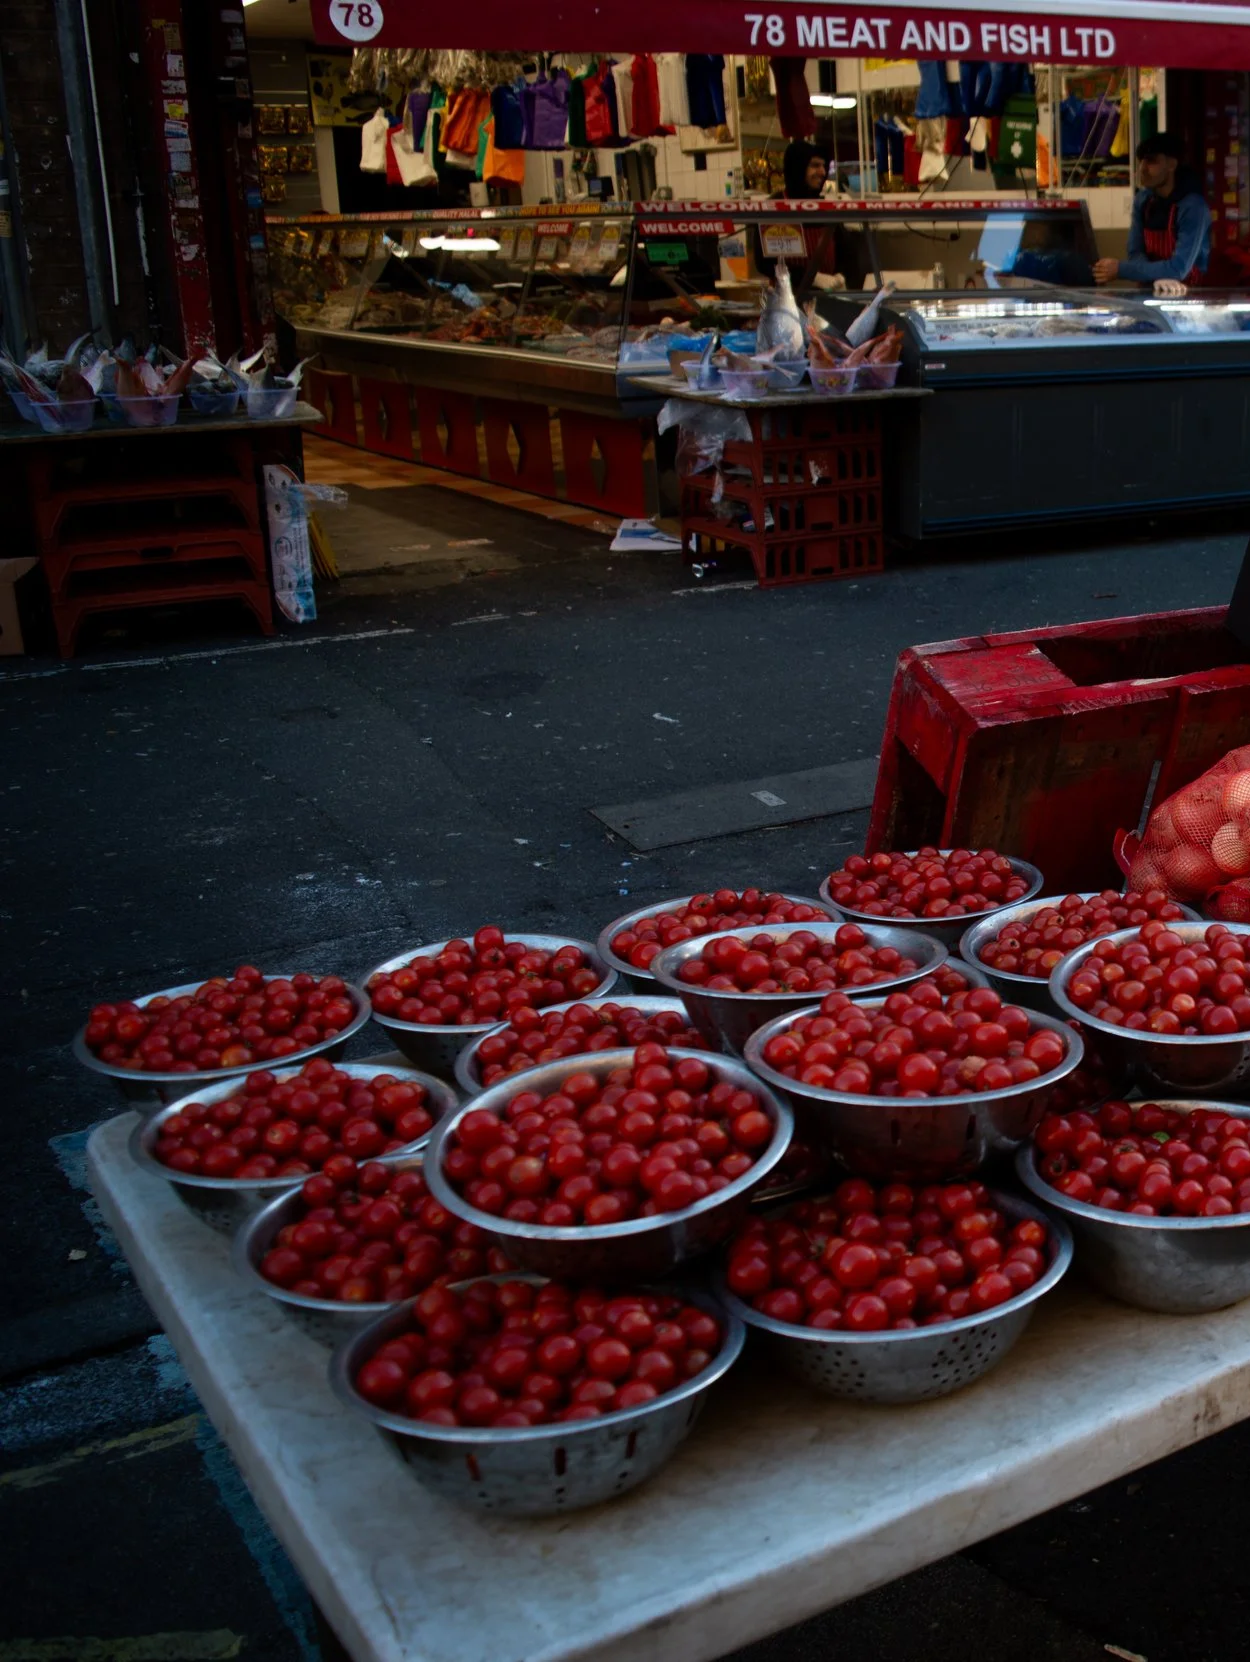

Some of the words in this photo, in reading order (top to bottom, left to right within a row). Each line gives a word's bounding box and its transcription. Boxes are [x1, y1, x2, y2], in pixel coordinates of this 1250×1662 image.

[338, 3, 374, 27] 78
[744, 13, 785, 48] 78
[795, 15, 893, 50] MEAT
[900, 19, 971, 53] AND
[979, 23, 1050, 57] FISH
[1060, 27, 1115, 59] LTD
[639, 201, 777, 212] WELCOME
[783, 201, 820, 211] TO
[833, 201, 858, 210] 78
[865, 201, 923, 210] MEAT
[931, 201, 976, 209] AND
[980, 201, 1029, 209] FISH
[1033, 200, 1069, 209] LTD
[641, 222, 724, 234] WELCOME
